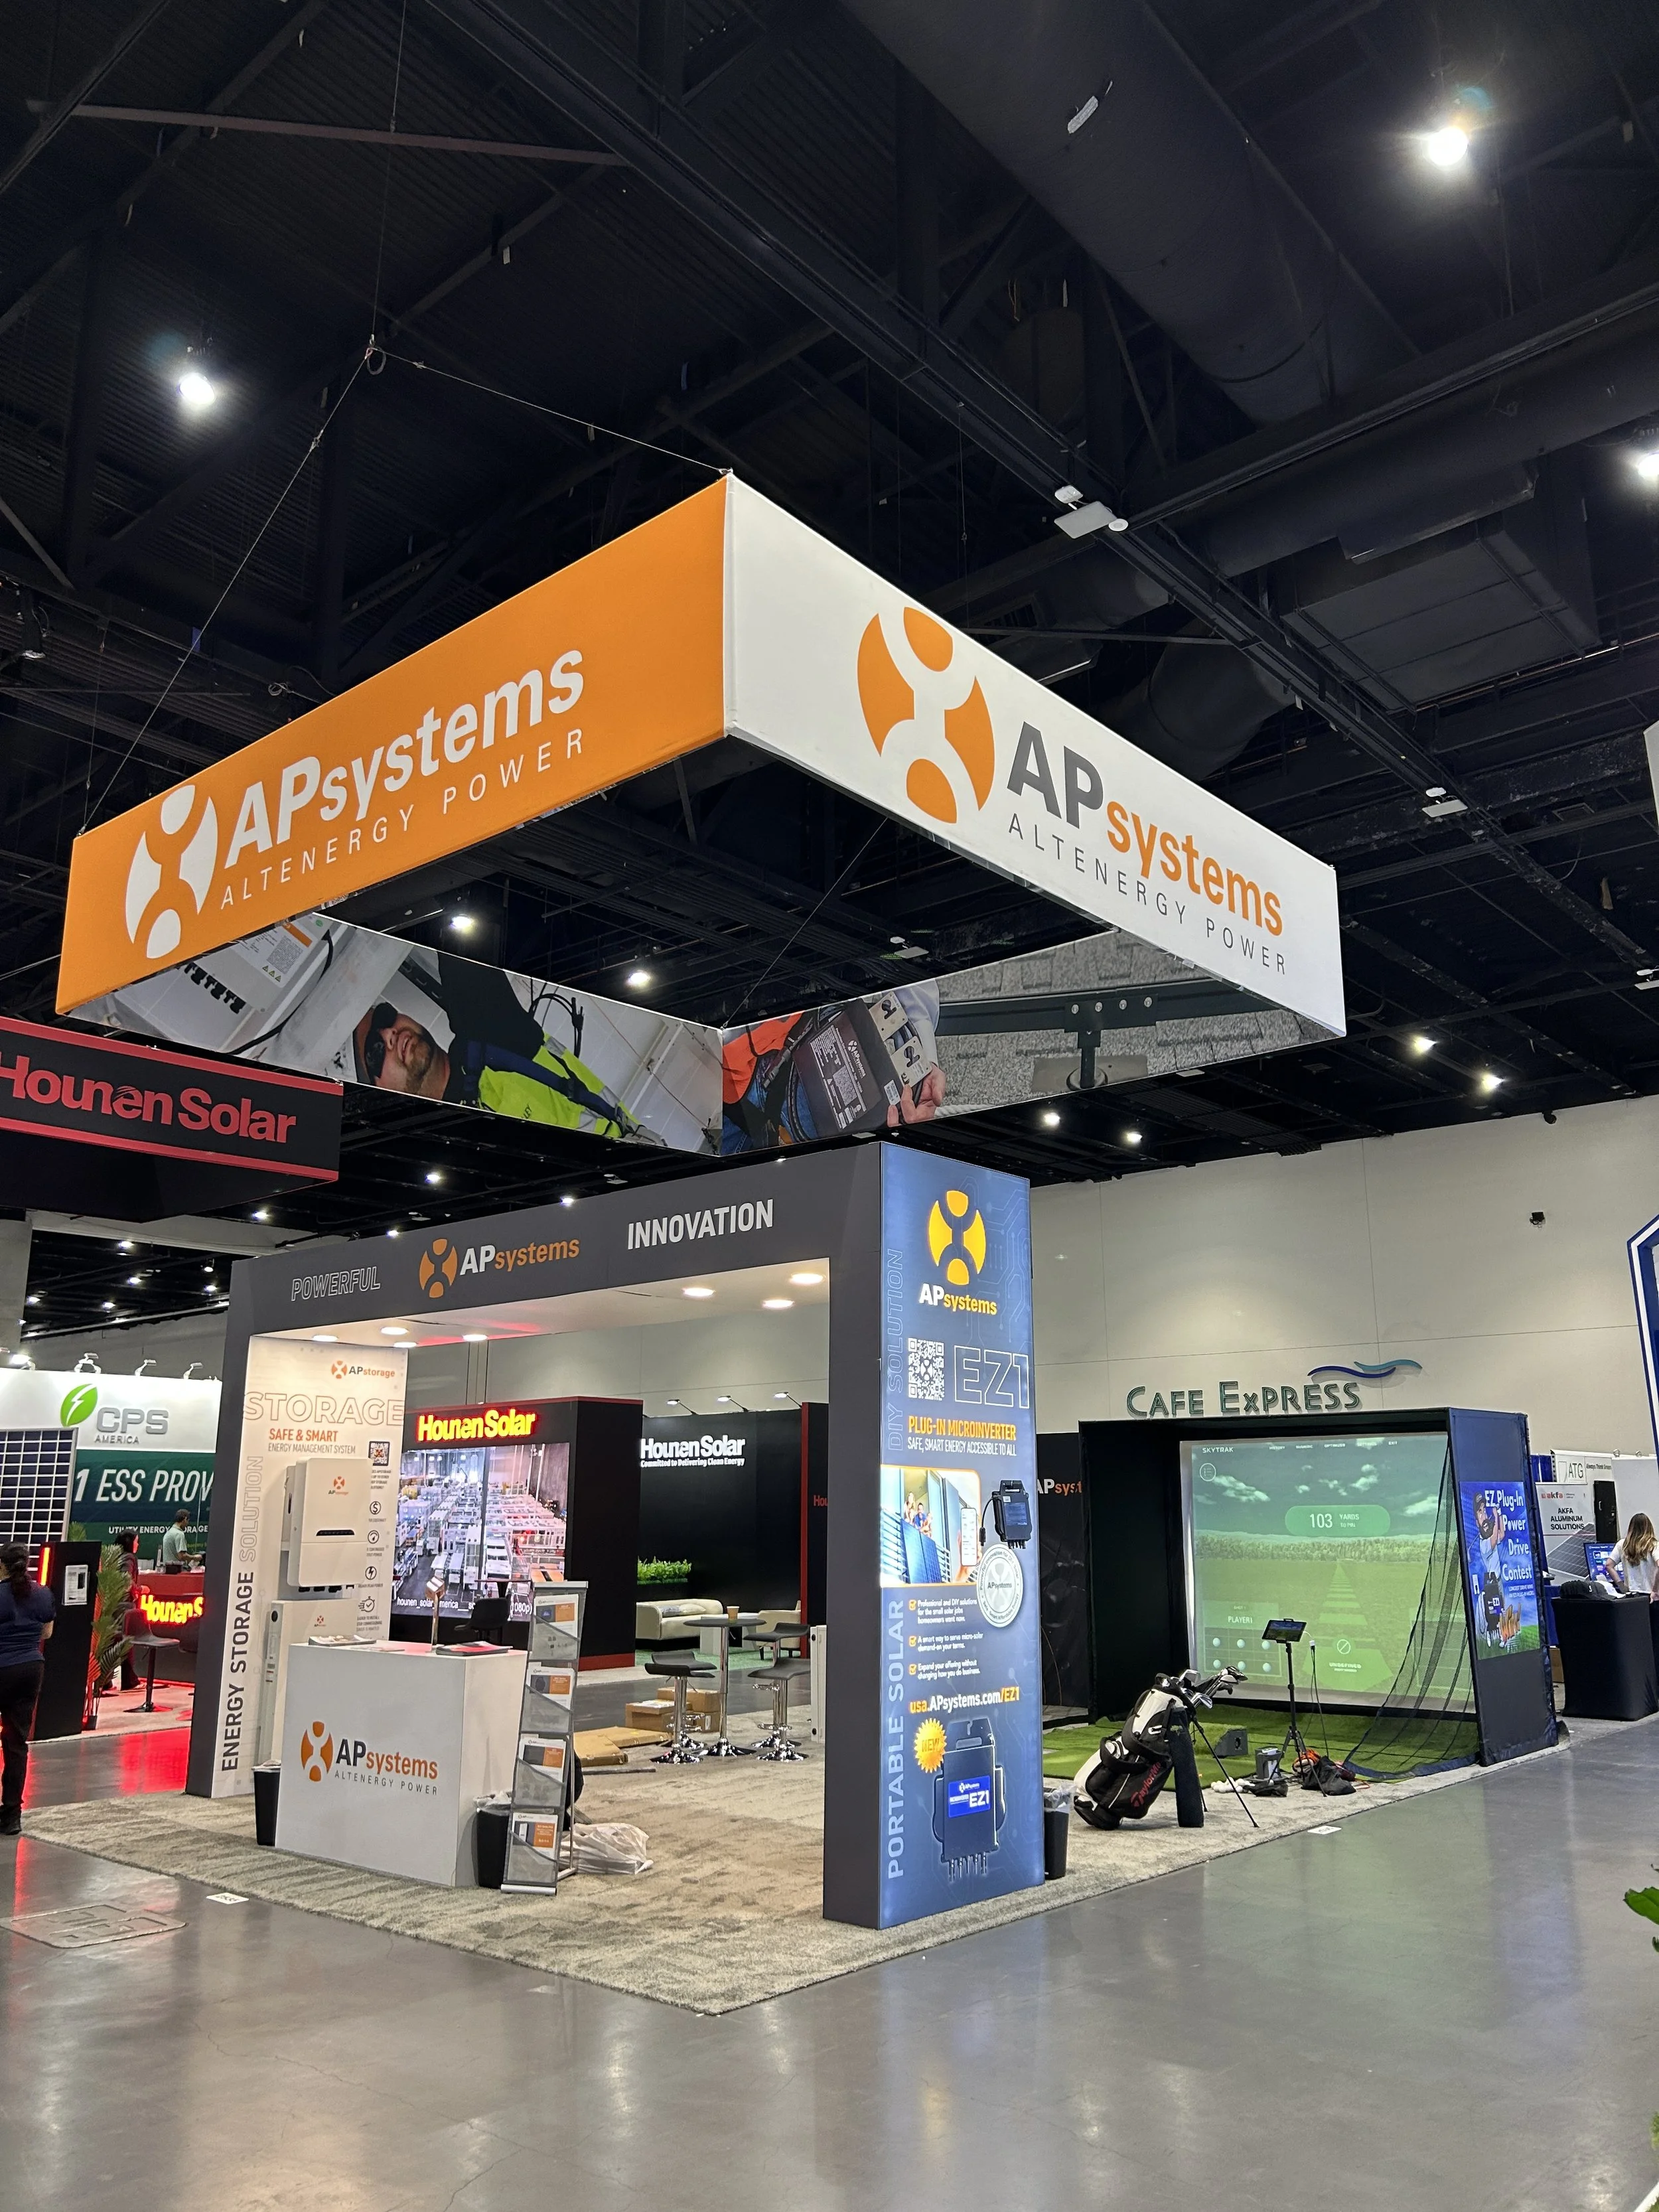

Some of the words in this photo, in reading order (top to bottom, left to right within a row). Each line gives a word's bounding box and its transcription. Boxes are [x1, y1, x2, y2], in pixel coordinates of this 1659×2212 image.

[224, 650, 583, 869] APsystems
[222, 804, 416, 909] ALTENERGY
[443, 729, 582, 814] POWER
[1007, 721, 1283, 936] APsystems
[1009, 814, 1187, 924] ALTENERGY
[1207, 918, 1286, 974] POWER
[628, 1199, 774, 1250] INNOVATION
[460, 1239, 580, 1276] APsystems
[291, 1266, 381, 1301] POWERFUL
[919, 1283, 997, 1315] APsystems
[887, 1249, 903, 1393] SOLUTION
[348, 1366, 396, 1378] APstorage
[954, 1345, 1030, 1409] EZ1
[243, 1391, 405, 1426] STORAGE
[1127, 1386, 1204, 1416] CAFE
[97, 1407, 169, 1435] CPS
[269, 1428, 294, 1441] SAFE
[296, 1429, 304, 1441] &
[305, 1430, 338, 1442] SMART
[888, 1403, 903, 1451] DIY
[908, 1415, 946, 1436] PLUG-IN
[948, 1420, 1017, 1441] MICROINVERTER
[94, 1435, 139, 1444] AMERICA
[268, 1443, 291, 1452] ENERGY
[293, 1443, 333, 1453] MANAGEMENT
[334, 1445, 356, 1454] SYSTEM
[908, 1436, 924, 1453] SAFE,
[924, 1438, 944, 1451] SMART
[945, 1439, 966, 1453] ENERGY
[967, 1441, 998, 1455] ACCESSIBLE
[999, 1443, 1006, 1455] TO
[1006, 1444, 1017, 1456] ALL
[678, 1458, 707, 1467] Delivering
[724, 1457, 745, 1467] Energy
[1568, 1462, 1584, 1479] ATG
[96, 1469, 146, 1502] ESS
[1484, 1490, 1496, 1507] EZ
[1496, 1489, 1524, 1512] Plug-In
[239, 1456, 263, 1562] SOLUTION
[1310, 1513, 1333, 1528] 103
[1502, 1514, 1526, 1531] Power
[1508, 1538, 1530, 1556] Drive
[987, 1582, 1013, 1590] APsystems
[1502, 1563, 1532, 1582] Contest
[230, 1572, 253, 1673] STORAGE
[888, 1600, 904, 1702] SOLAR
[909, 1686, 1021, 1714] usa.APsystems.com/EZ1
[222, 1684, 245, 1771] ENERGY
[335, 1739, 438, 1780] APsystems
[922, 1737, 940, 1753] NEW
[334, 1770, 394, 1788] ALTENERGY
[400, 1780, 438, 1796] POWER
[888, 1716, 904, 1880] PORTABLE
[969, 1789, 989, 1808] EZ1
